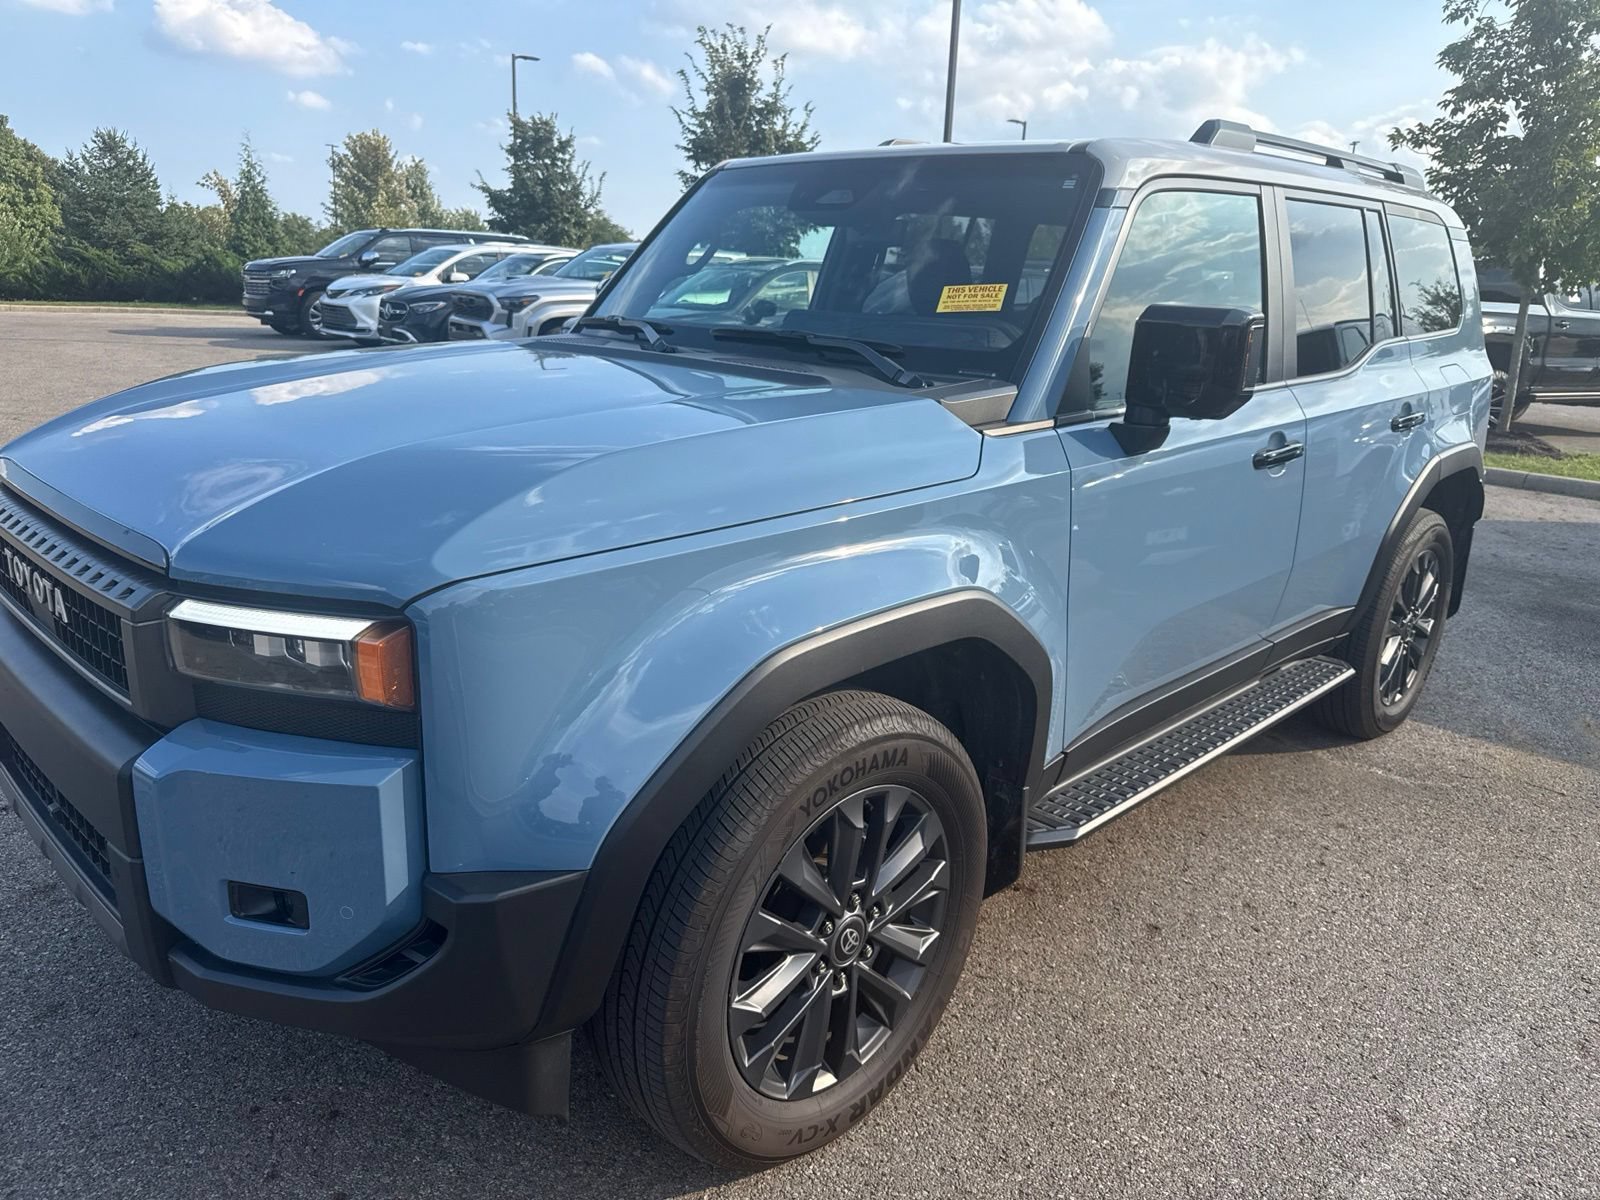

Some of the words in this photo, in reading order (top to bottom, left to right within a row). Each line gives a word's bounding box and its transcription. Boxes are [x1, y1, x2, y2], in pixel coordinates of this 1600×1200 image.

[947, 286, 966, 294] THIS
[968, 285, 1004, 293] VEHICLE
[2, 547, 68, 623] TOYOTA
[799, 747, 908, 817] YOKOHAMA
